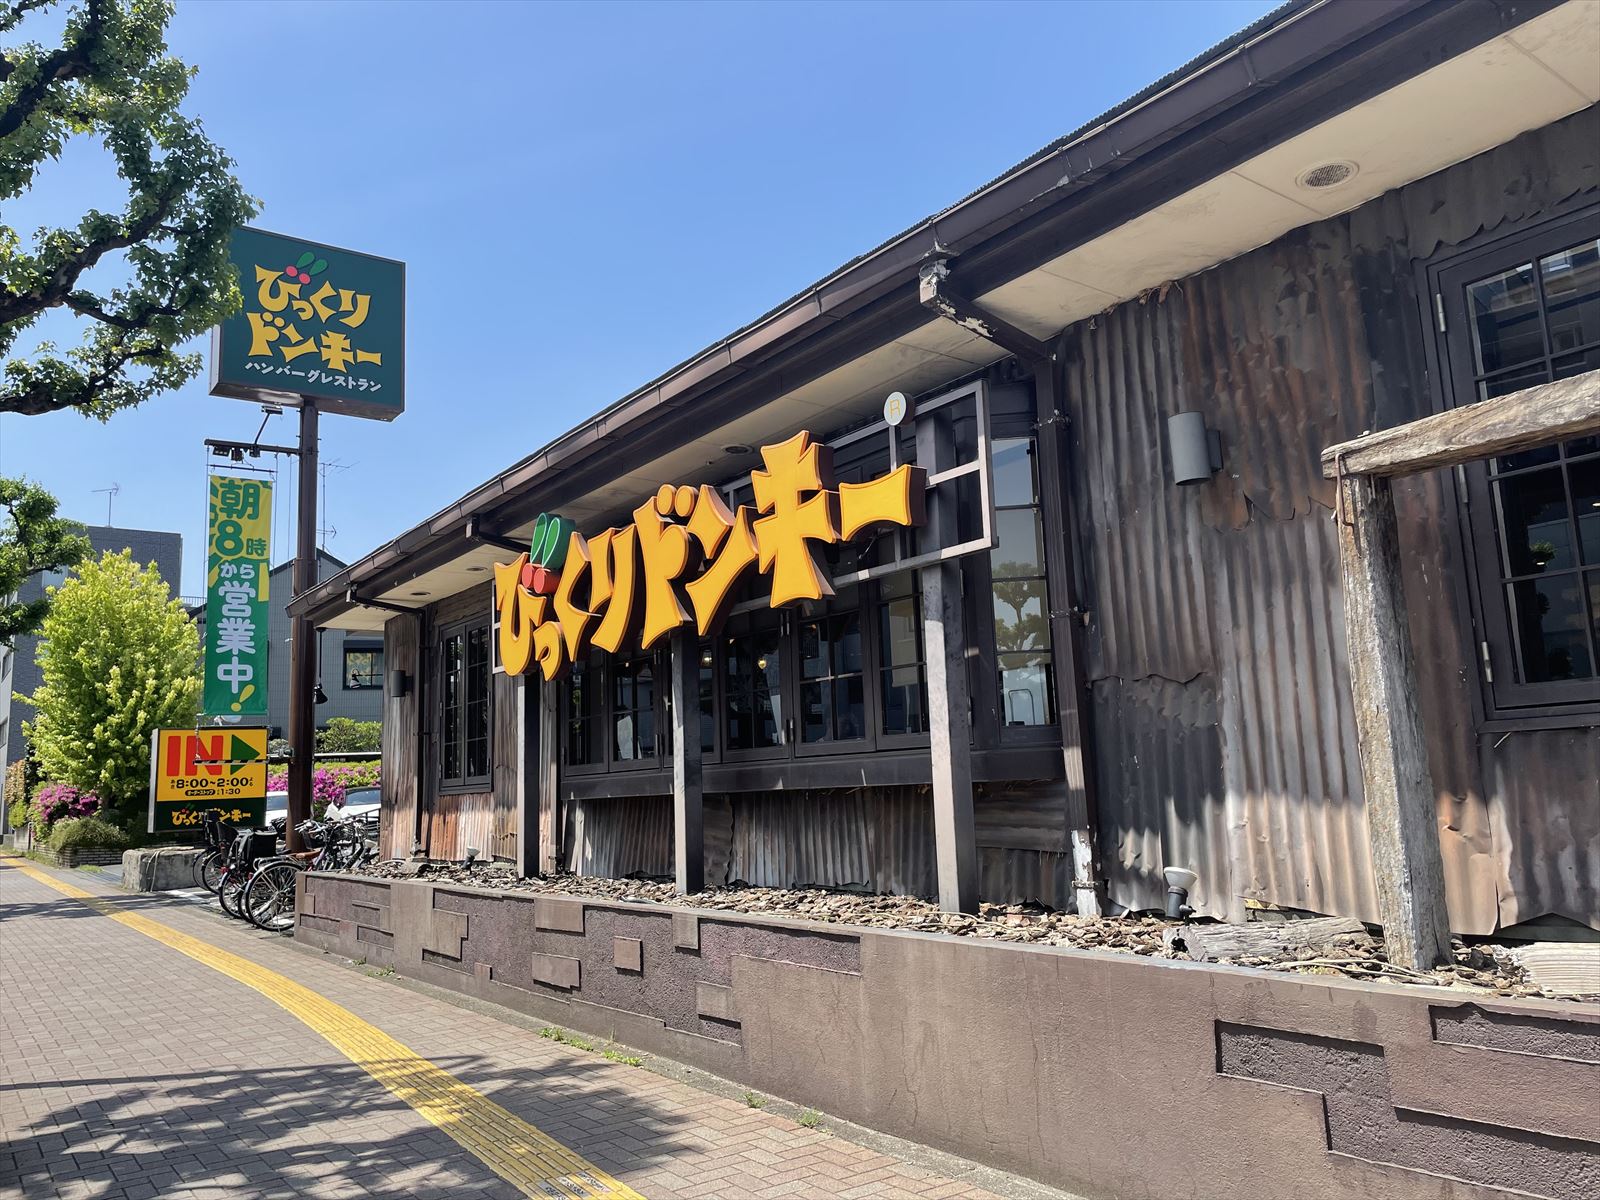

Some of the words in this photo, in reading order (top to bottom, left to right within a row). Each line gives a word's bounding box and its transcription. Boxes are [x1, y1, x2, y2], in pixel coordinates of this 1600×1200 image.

[255, 264, 371, 329] びっくり
[246, 311, 382, 373] ドンキー
[244, 362, 382, 392] ハンバーグレストラン
[219, 480, 260, 520] 朝
[215, 520, 267, 556] 8時
[494, 430, 914, 682] びっくりドンキー
[220, 562, 255, 579] から
[166, 735, 224, 777] IN
